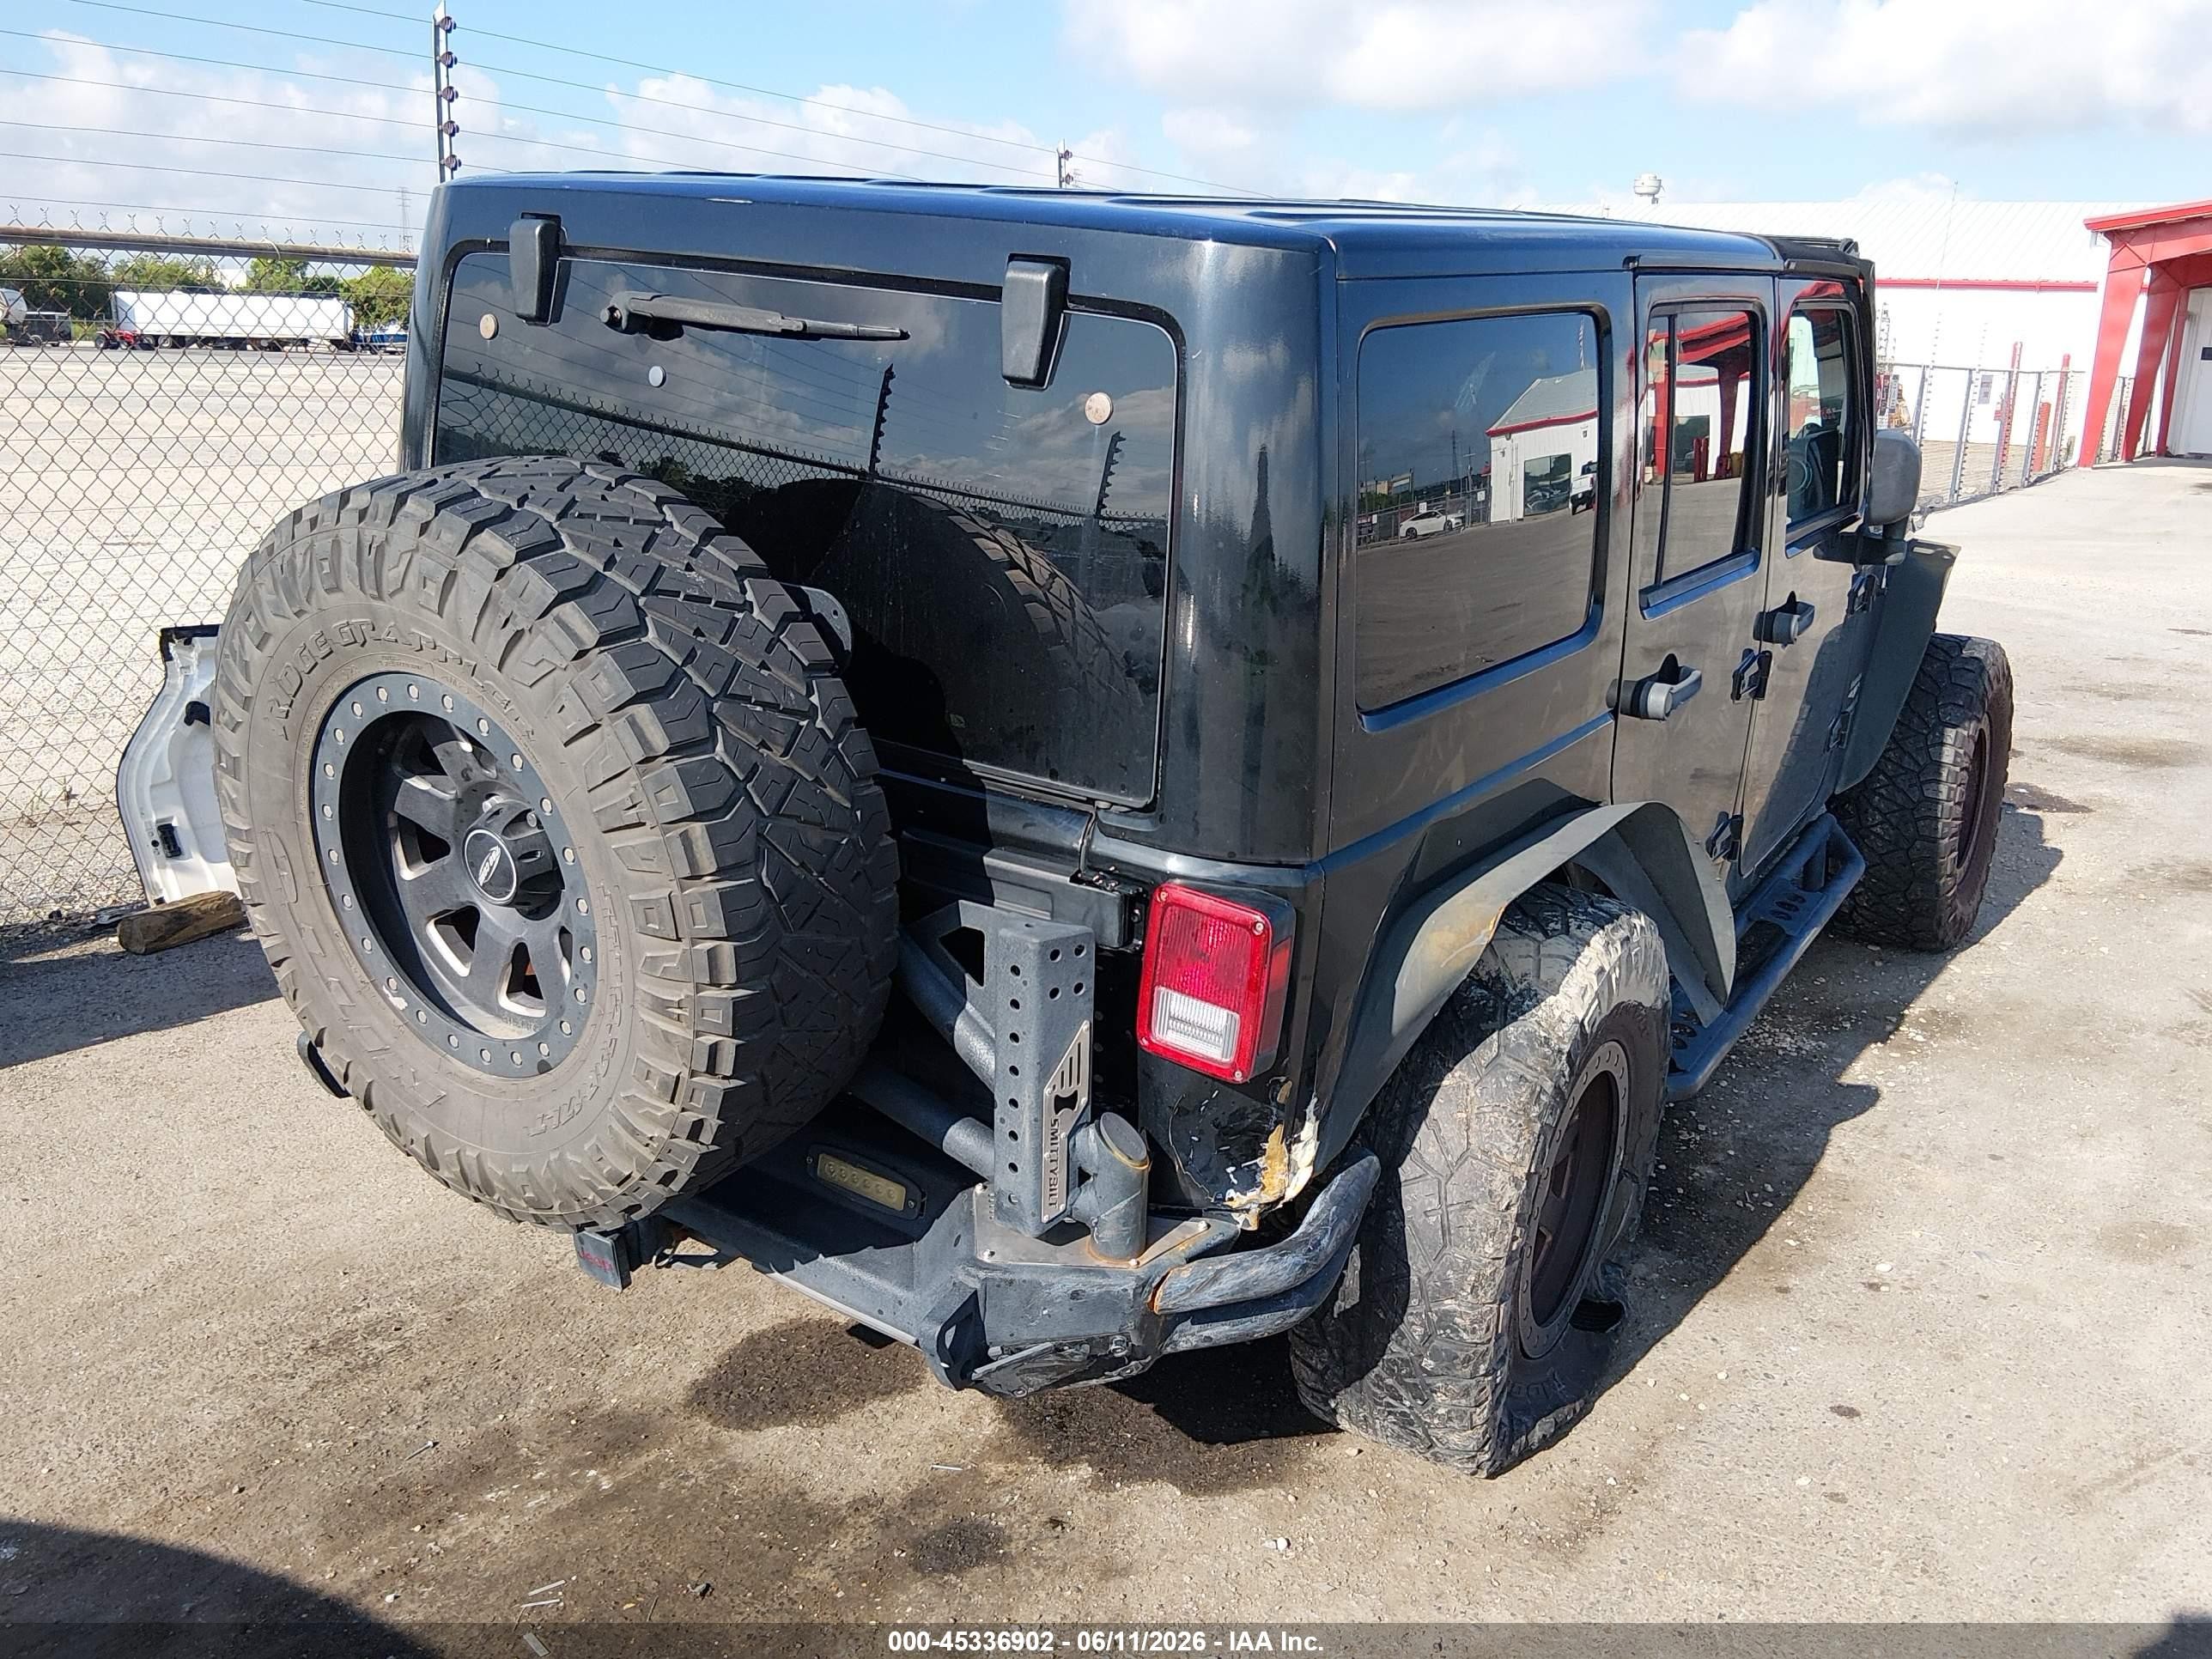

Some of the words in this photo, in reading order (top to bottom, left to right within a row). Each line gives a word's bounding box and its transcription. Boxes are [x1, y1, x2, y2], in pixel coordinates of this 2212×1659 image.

[264, 630, 334, 741] RIDGE
[1048, 1118, 1060, 1209] SMITTYBILT
[578, 1245, 613, 1273] Jeep
